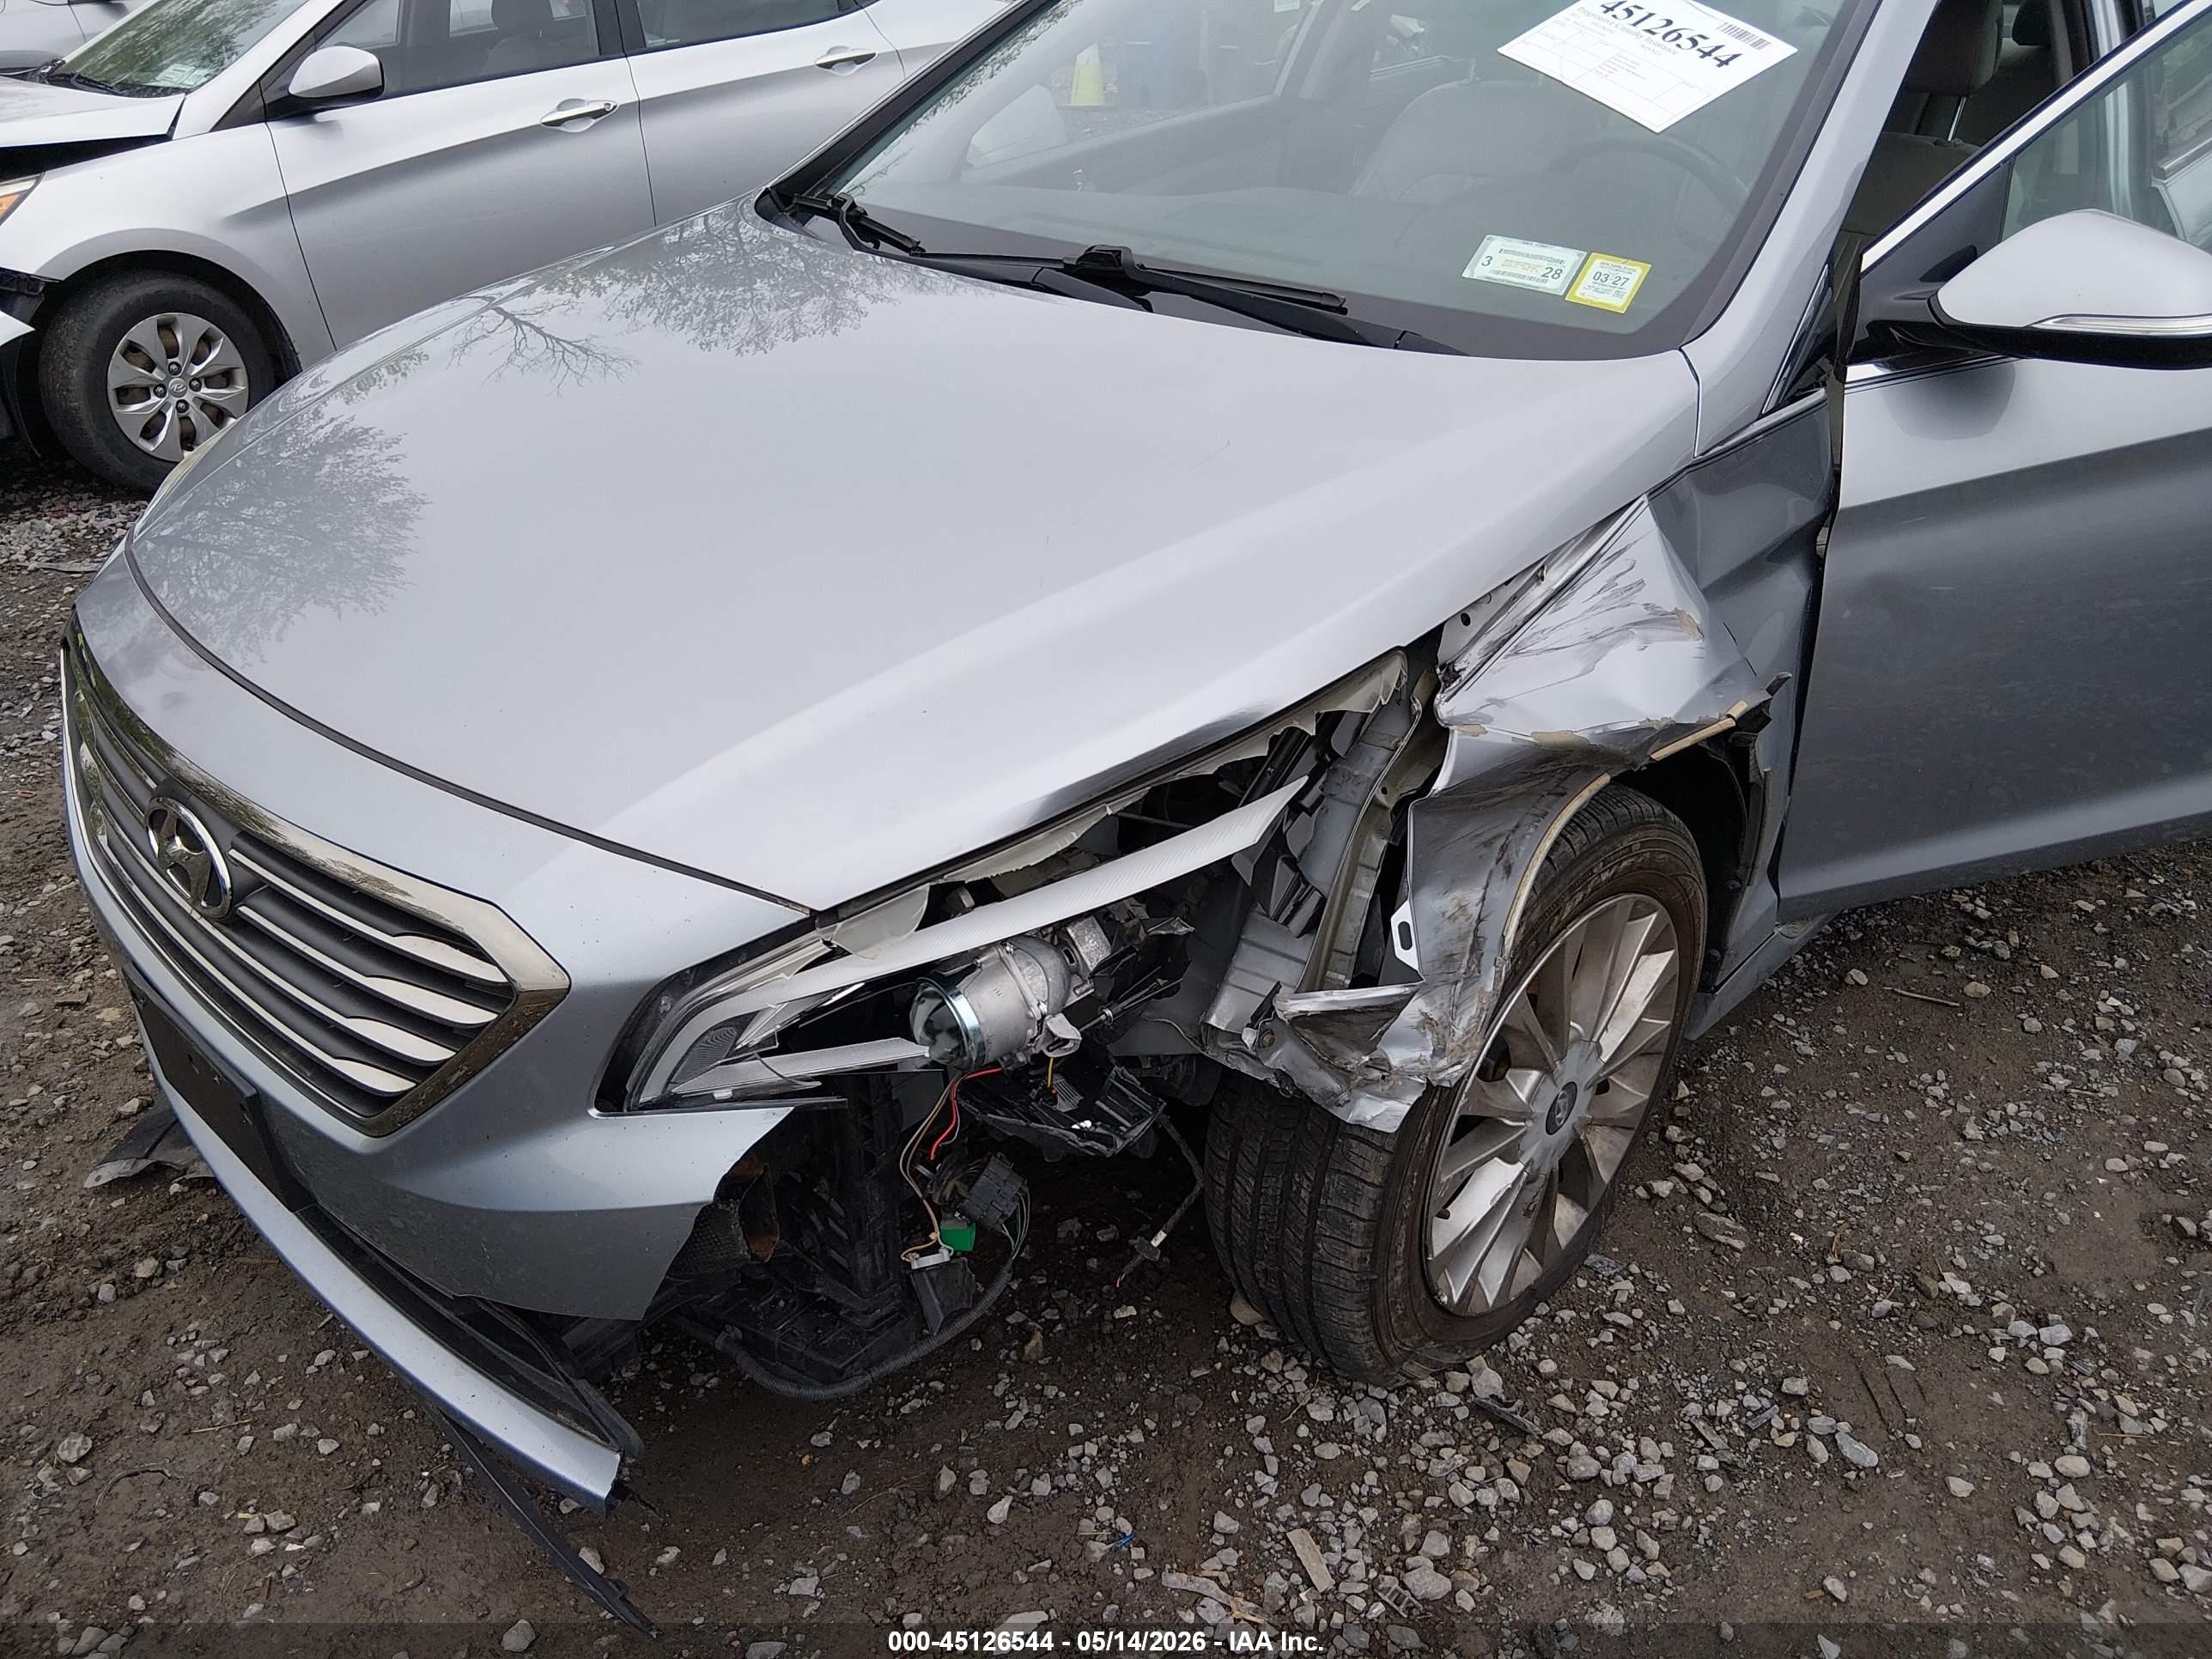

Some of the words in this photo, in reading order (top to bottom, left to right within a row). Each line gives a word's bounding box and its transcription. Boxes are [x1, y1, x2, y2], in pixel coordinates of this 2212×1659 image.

[1600, 0, 1743, 68] 45126544
[1481, 255, 1493, 267] 3
[1540, 266, 1563, 280] 28
